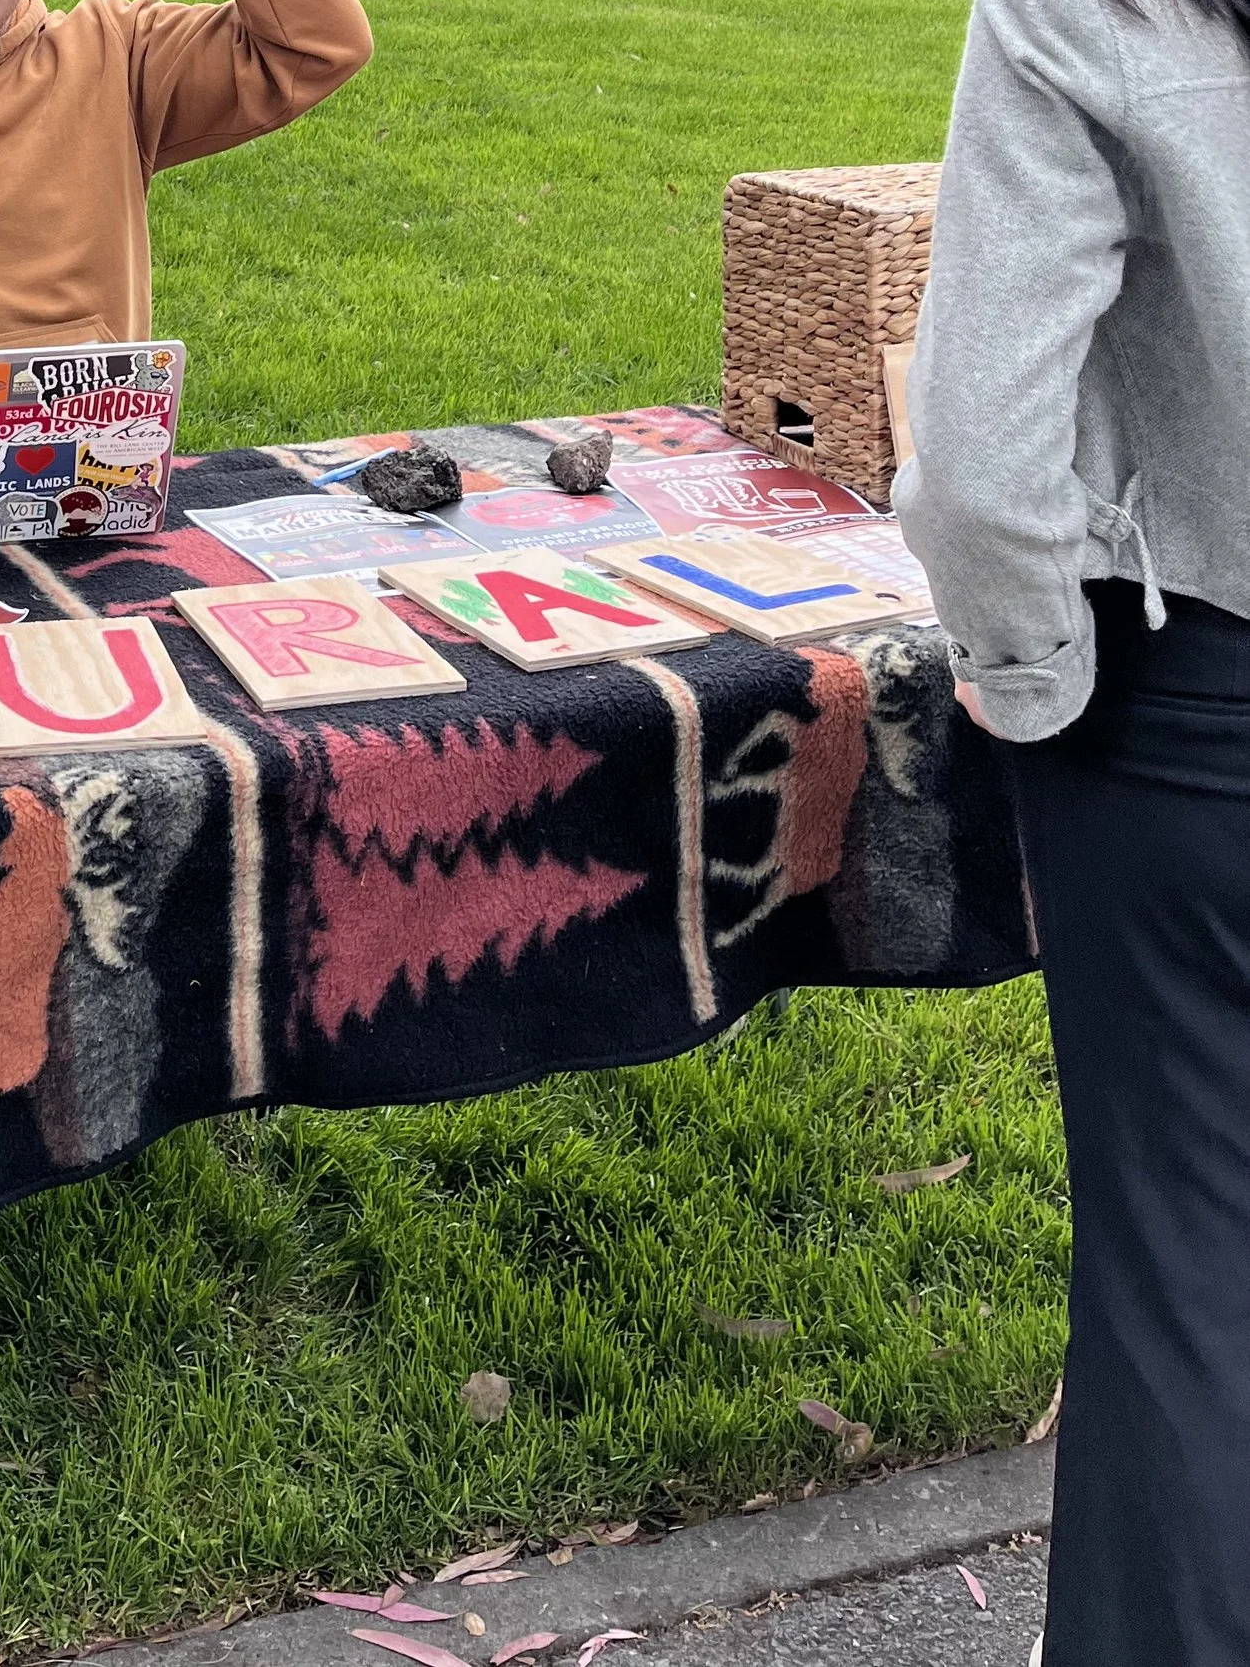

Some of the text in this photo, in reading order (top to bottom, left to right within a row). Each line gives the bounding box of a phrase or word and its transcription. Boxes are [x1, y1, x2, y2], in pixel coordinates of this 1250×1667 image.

[43, 356, 108, 390] BORN
[5, 408, 34, 420] 53rd
[57, 391, 168, 423] FOUROSIX
[8, 424, 85, 443] Land
[83, 429, 101, 439] is
[688, 459, 781, 472] DANCIN
[26, 475, 71, 490] LANDS
[9, 503, 46, 516] VOTE
[501, 519, 656, 547] OAKLAND PBR RODE
[775, 518, 845, 533] RURAL
[594, 528, 635, 540] APRIL
